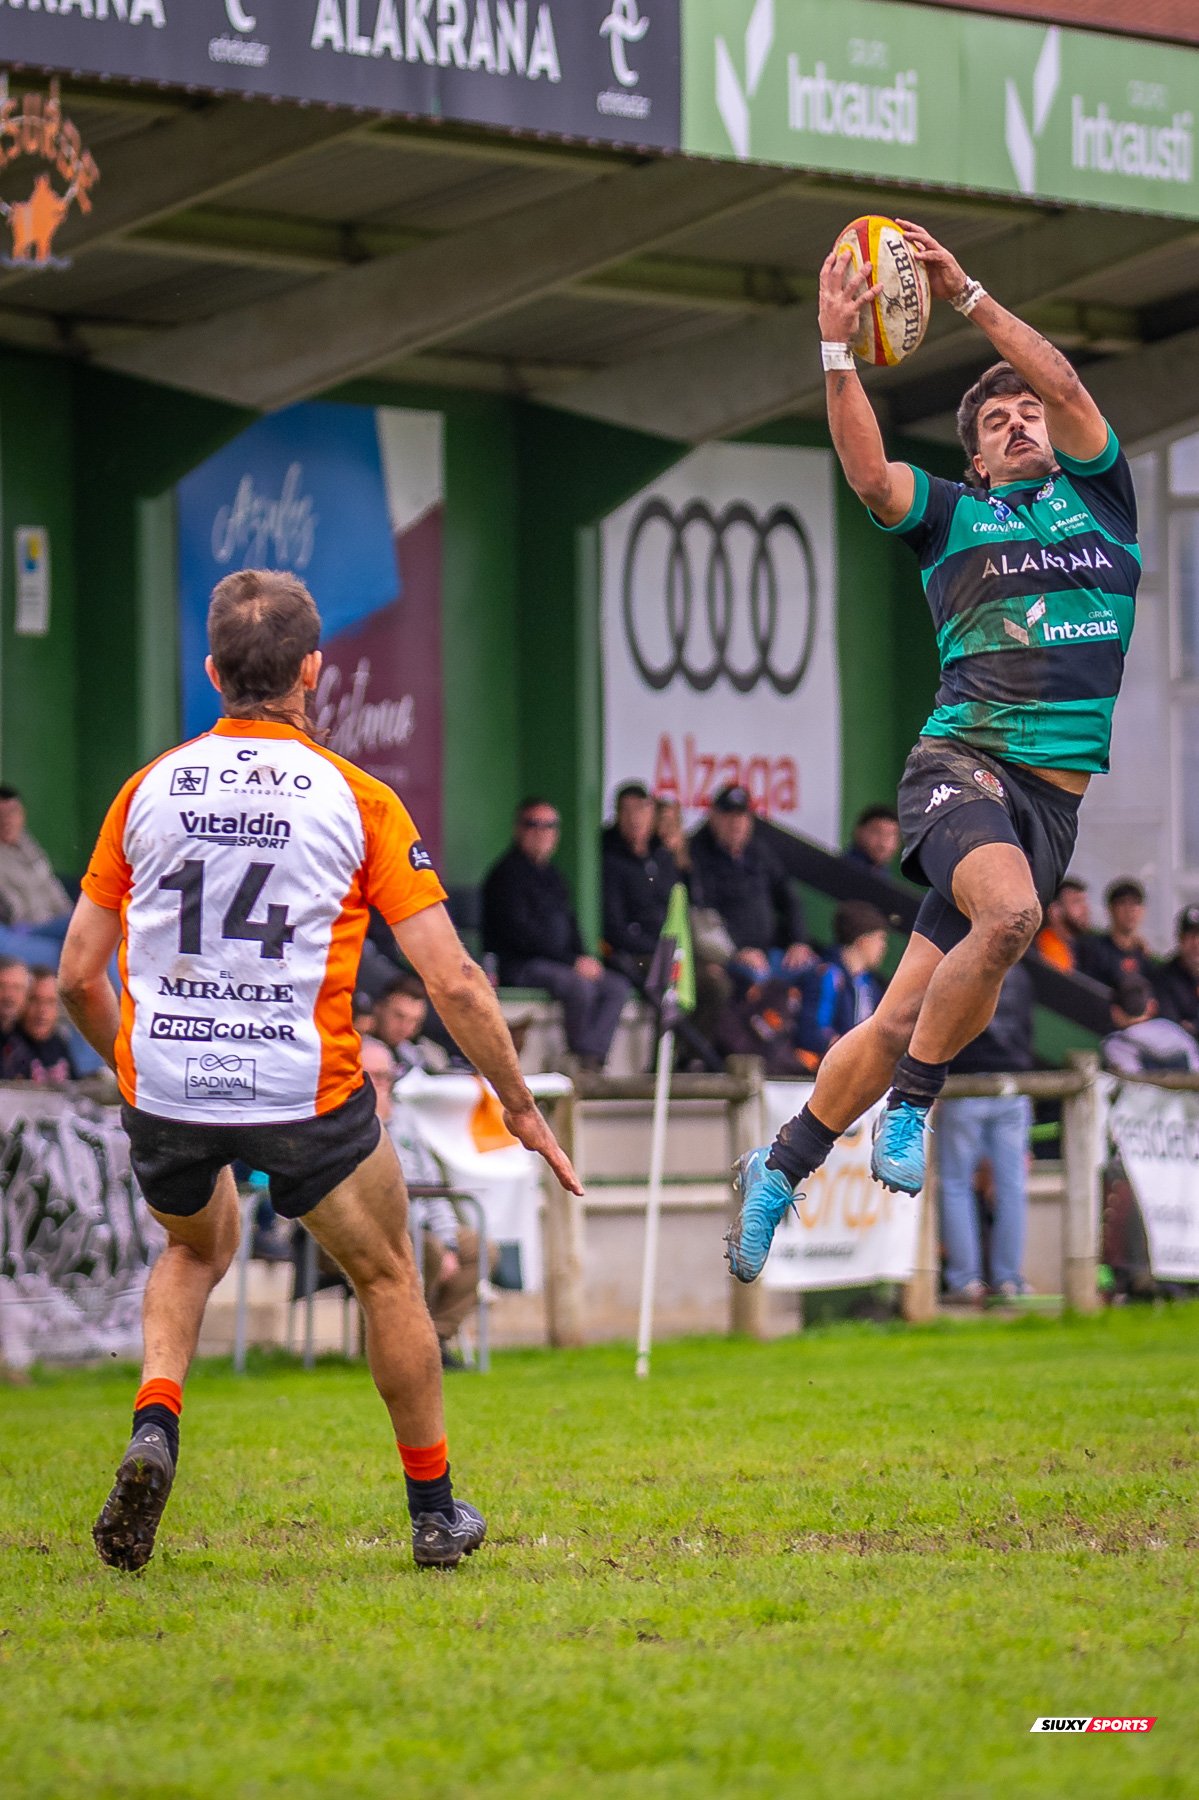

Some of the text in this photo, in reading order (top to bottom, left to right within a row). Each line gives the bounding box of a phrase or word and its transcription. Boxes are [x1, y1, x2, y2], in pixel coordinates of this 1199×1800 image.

[311, 0, 562, 83] ALAKRANA
[788, 52, 918, 145] Intxausti
[1072, 93, 1192, 183] Intxausti
[886, 239, 920, 351] GILBERT
[219, 769, 312, 790] CAVO
[179, 810, 291, 838] Vitaldin
[237, 836, 290, 850] SPORT
[159, 858, 297, 960] 14
[219, 970, 234, 979] EL
[157, 976, 294, 1003] MIRACLE
[189, 1075, 252, 1089] SADIVAL
